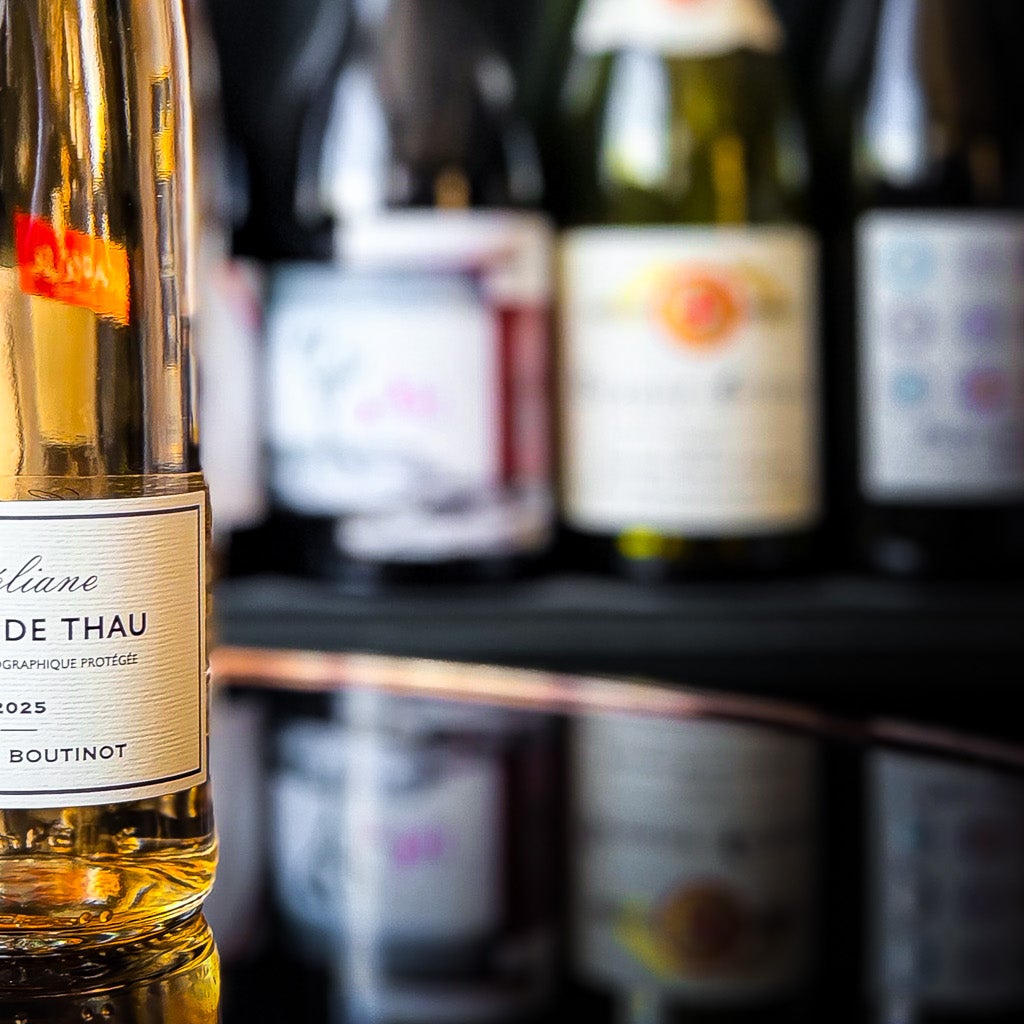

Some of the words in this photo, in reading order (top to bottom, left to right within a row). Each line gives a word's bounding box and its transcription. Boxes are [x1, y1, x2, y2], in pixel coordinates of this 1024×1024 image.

[4, 618, 47, 642] DE
[61, 612, 147, 640] THAU
[80, 653, 139, 669] PROTÉGÉE
[9, 742, 128, 764] BOUTINOT
